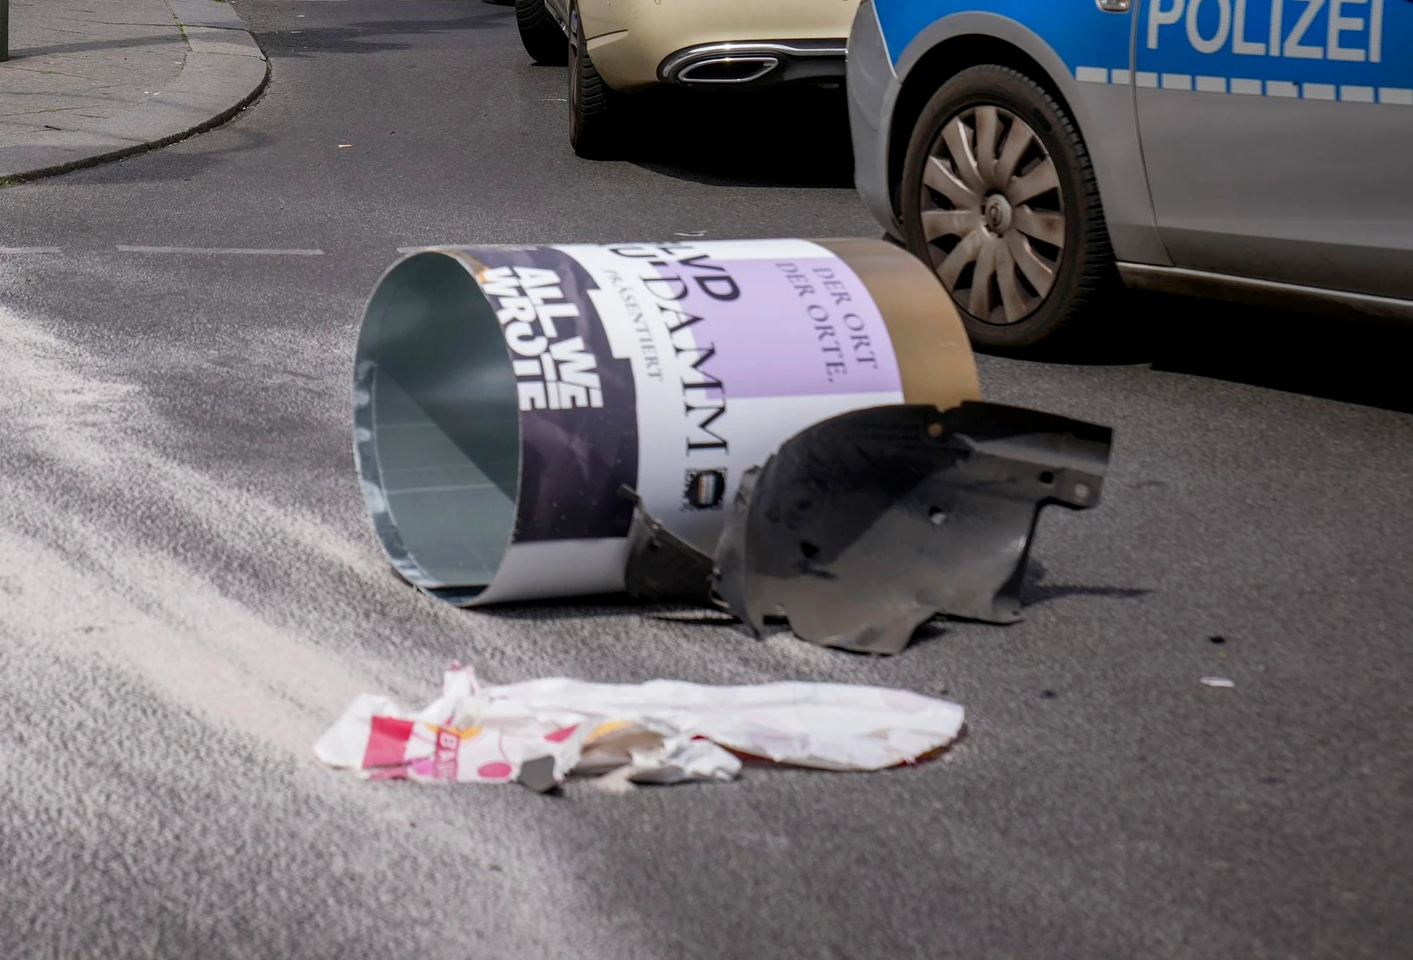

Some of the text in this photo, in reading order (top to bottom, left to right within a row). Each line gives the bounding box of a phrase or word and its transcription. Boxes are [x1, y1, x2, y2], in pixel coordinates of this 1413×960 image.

[513, 266, 580, 338] ALL
[775, 263, 848, 383] DER ORTE.
[812, 268, 878, 369] DER ORT
